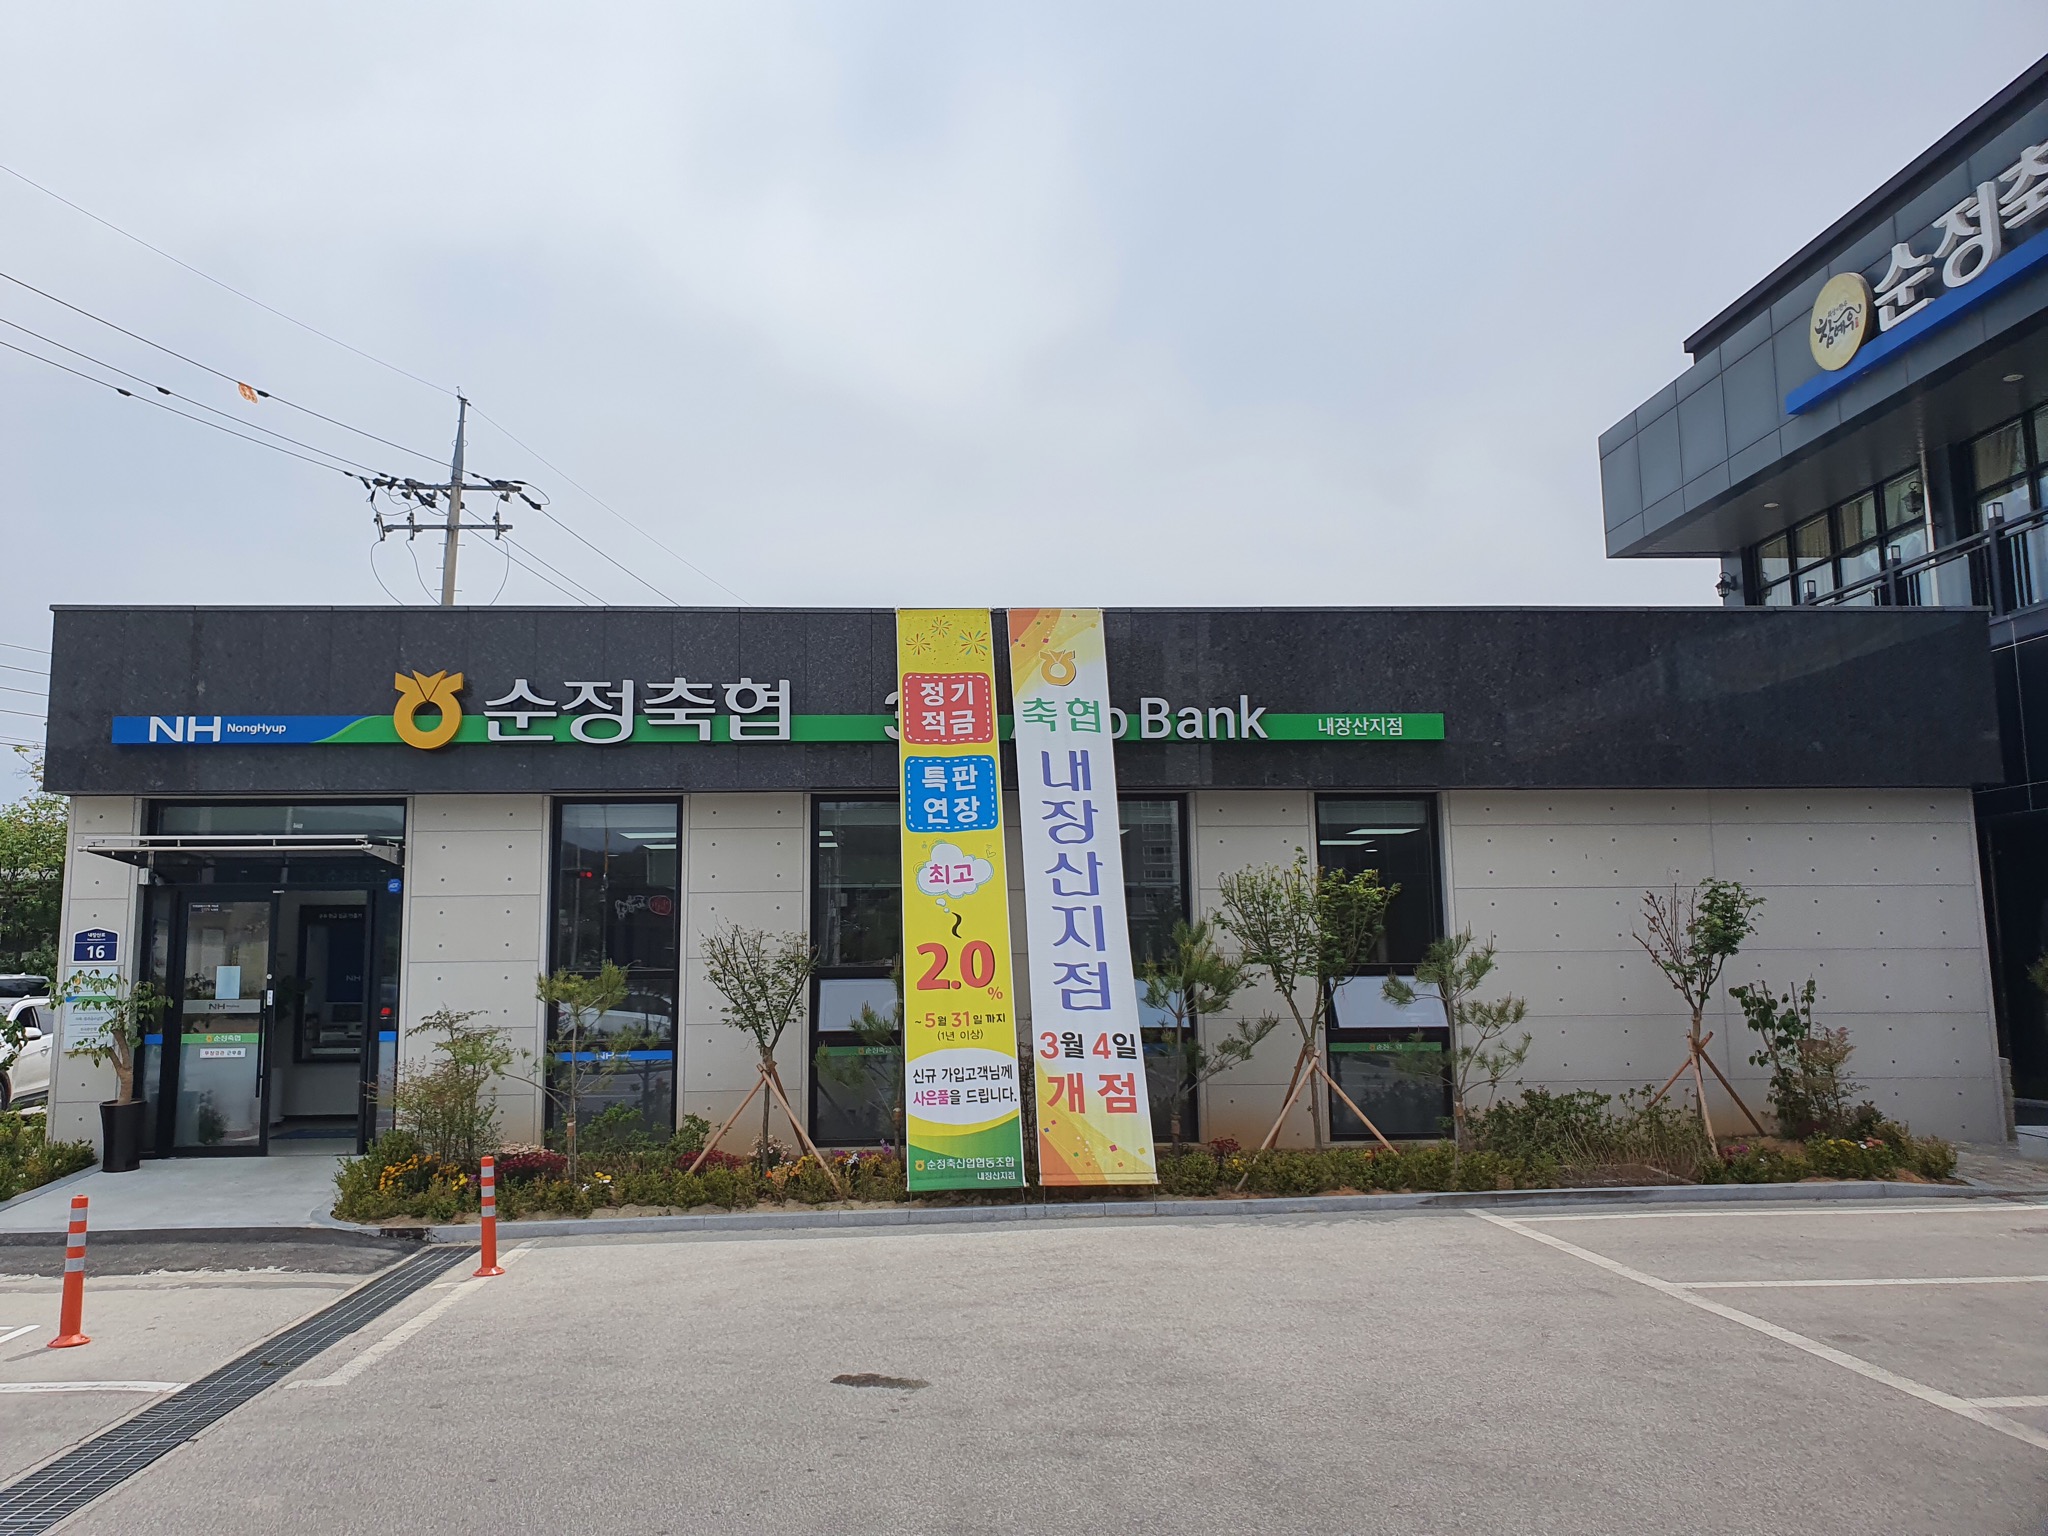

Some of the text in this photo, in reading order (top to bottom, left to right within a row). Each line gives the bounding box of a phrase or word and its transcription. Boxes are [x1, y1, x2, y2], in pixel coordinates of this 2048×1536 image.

[920, 681, 975, 707] 정기
[483, 677, 791, 744] 순정축협
[921, 709, 976, 736] 적금
[1022, 697, 1101, 733] 축협
[1140, 695, 1268, 740] Bank
[149, 716, 286, 742] NH NongHyup
[1318, 717, 1403, 737] 내장산지점
[921, 765, 979, 792] 특판
[924, 796, 981, 824] 연장
[929, 863, 974, 884] 최고
[1041, 749, 1112, 1011] 내장산지점
[87, 945, 105, 959] 16
[951, 1011, 983, 1028] 31일
[985, 1013, 1006, 1024] 까지
[937, 1029, 984, 1041] (1년 이상)
[1040, 1031, 1137, 1060] 3월 4일
[913, 1064, 1013, 1084] 신규 가입고객님께
[913, 1086, 1017, 1106] 사은품을 드립니다.
[927, 1156, 1015, 1171] 순정축산업협동조합
[977, 1171, 1016, 1180] 내장산지점
